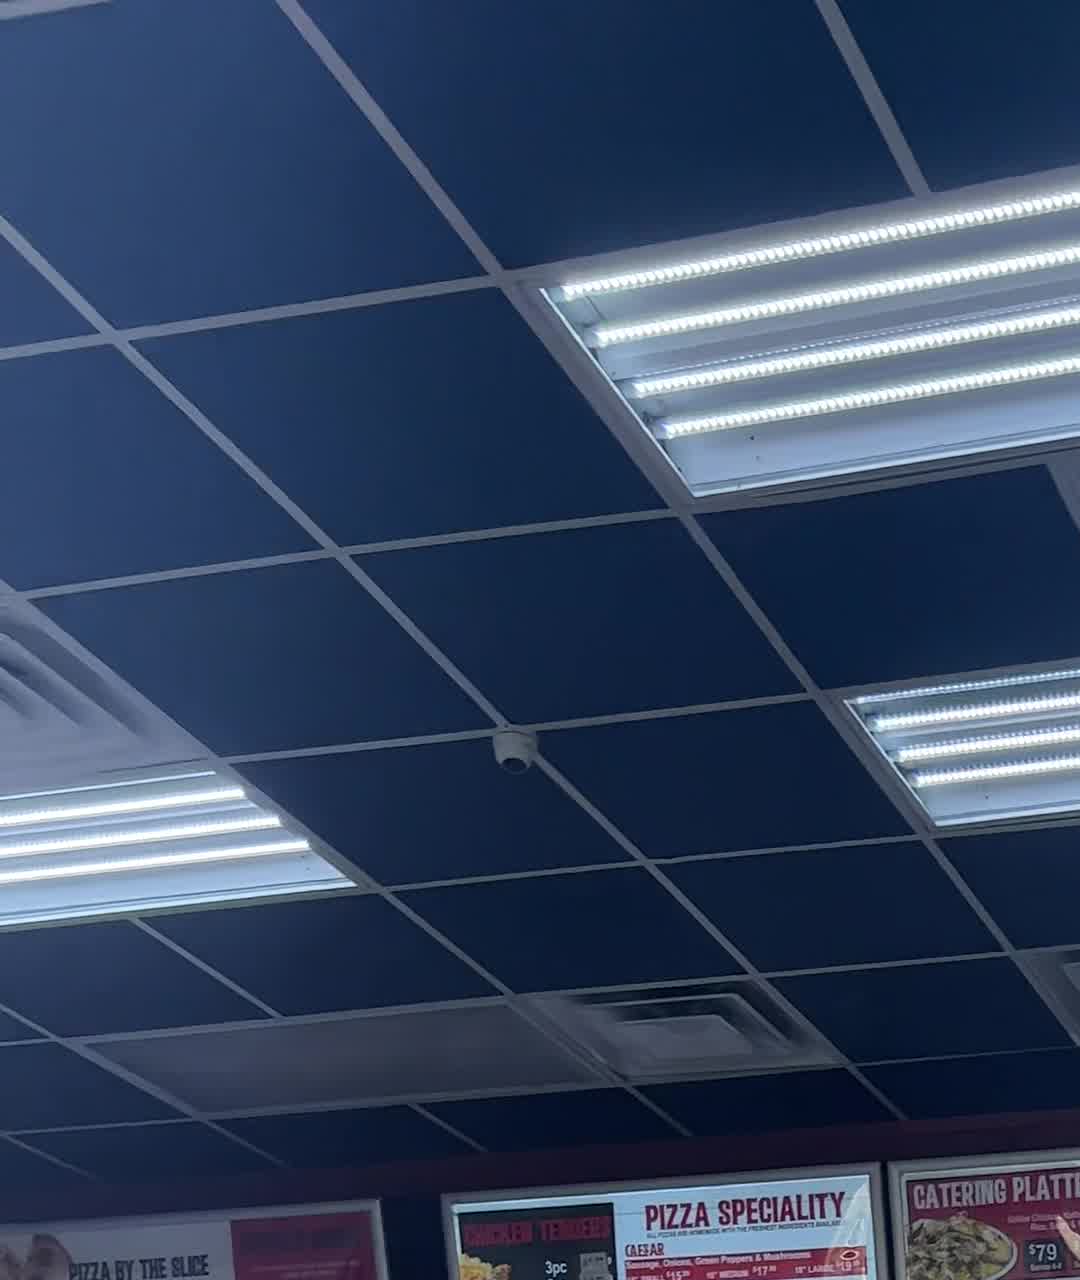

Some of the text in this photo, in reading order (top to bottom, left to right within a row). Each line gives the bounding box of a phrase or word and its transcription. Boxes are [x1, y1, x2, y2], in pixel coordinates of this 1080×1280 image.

[913, 1179, 1006, 1210] CATERING
[645, 1202, 711, 1231] PIZZA
[718, 1191, 846, 1225] SPECIALITY
[1029, 1243, 1057, 1261] $79
[115, 1260, 135, 1280] BY
[139, 1257, 166, 1279] THE
[171, 1254, 209, 1277] SLICE
[545, 1260, 568, 1276] 3pc
